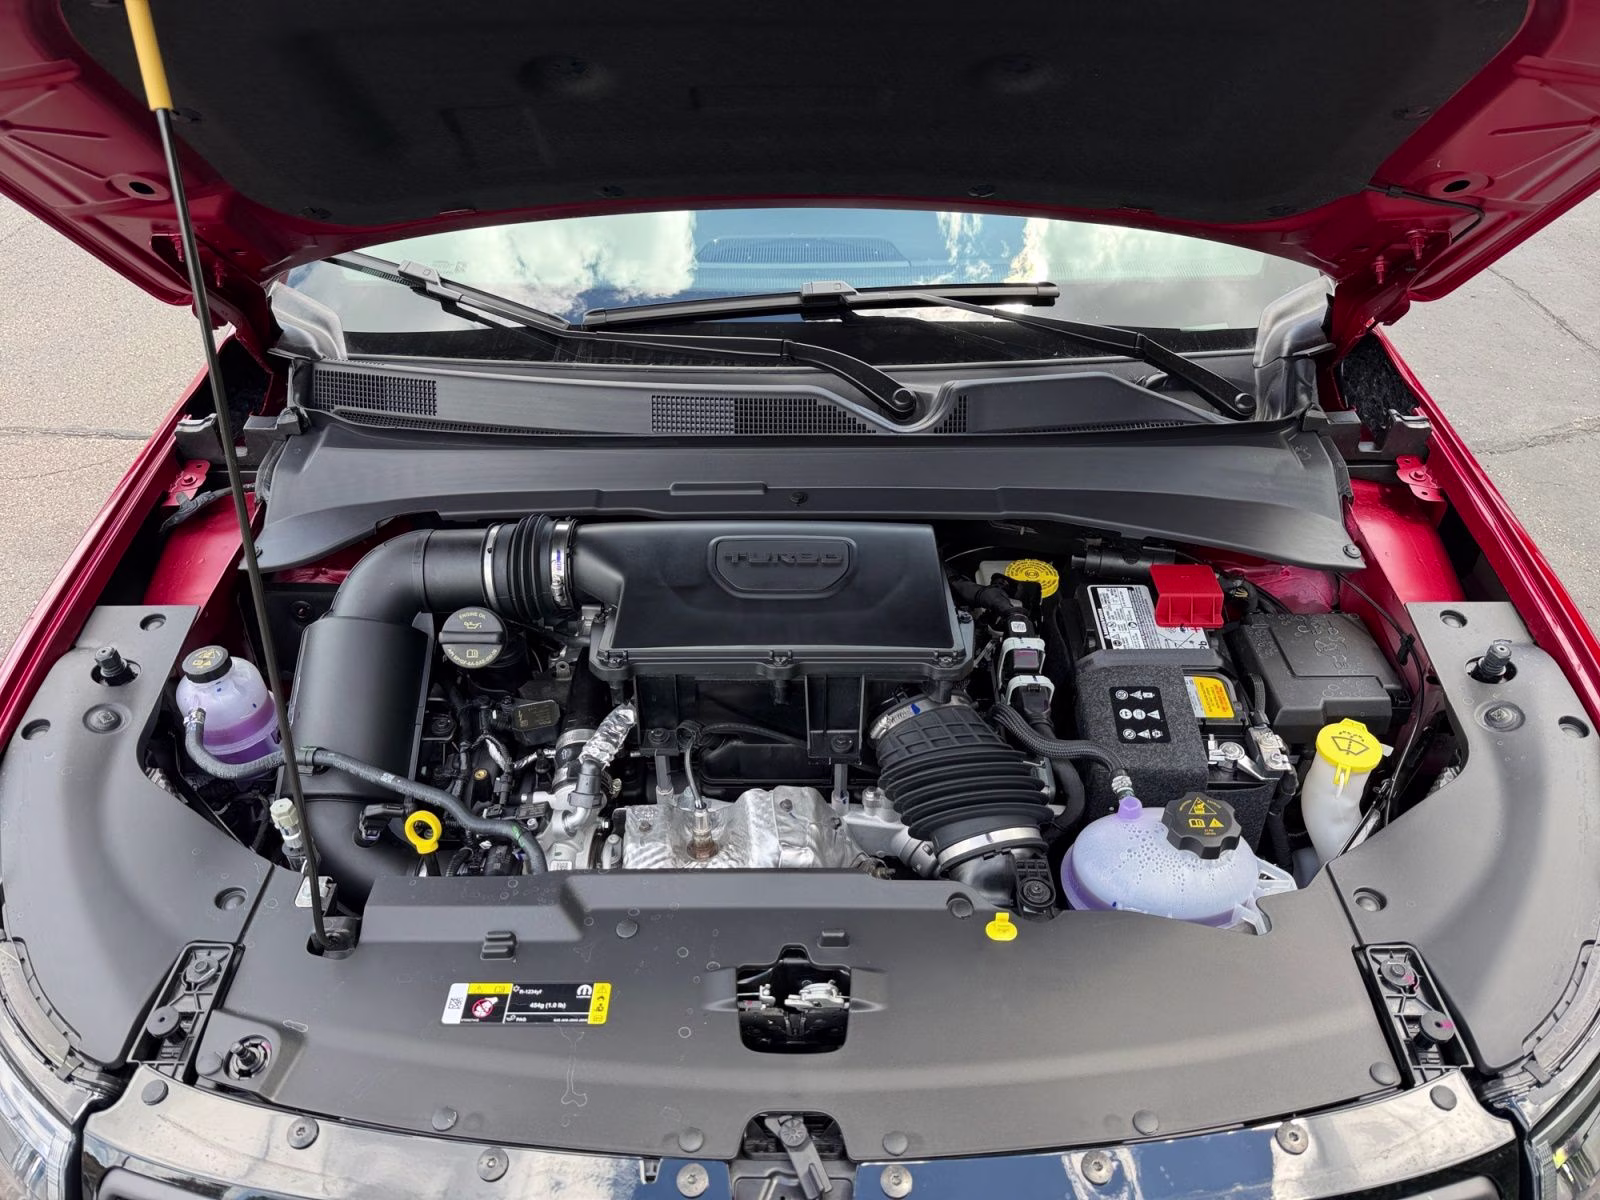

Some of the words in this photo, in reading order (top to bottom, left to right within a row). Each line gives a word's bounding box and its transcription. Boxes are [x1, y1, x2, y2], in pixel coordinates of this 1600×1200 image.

[724, 551, 844, 565] TURBO
[458, 612, 478, 620] ENGINE
[478, 612, 487, 620] OIL
